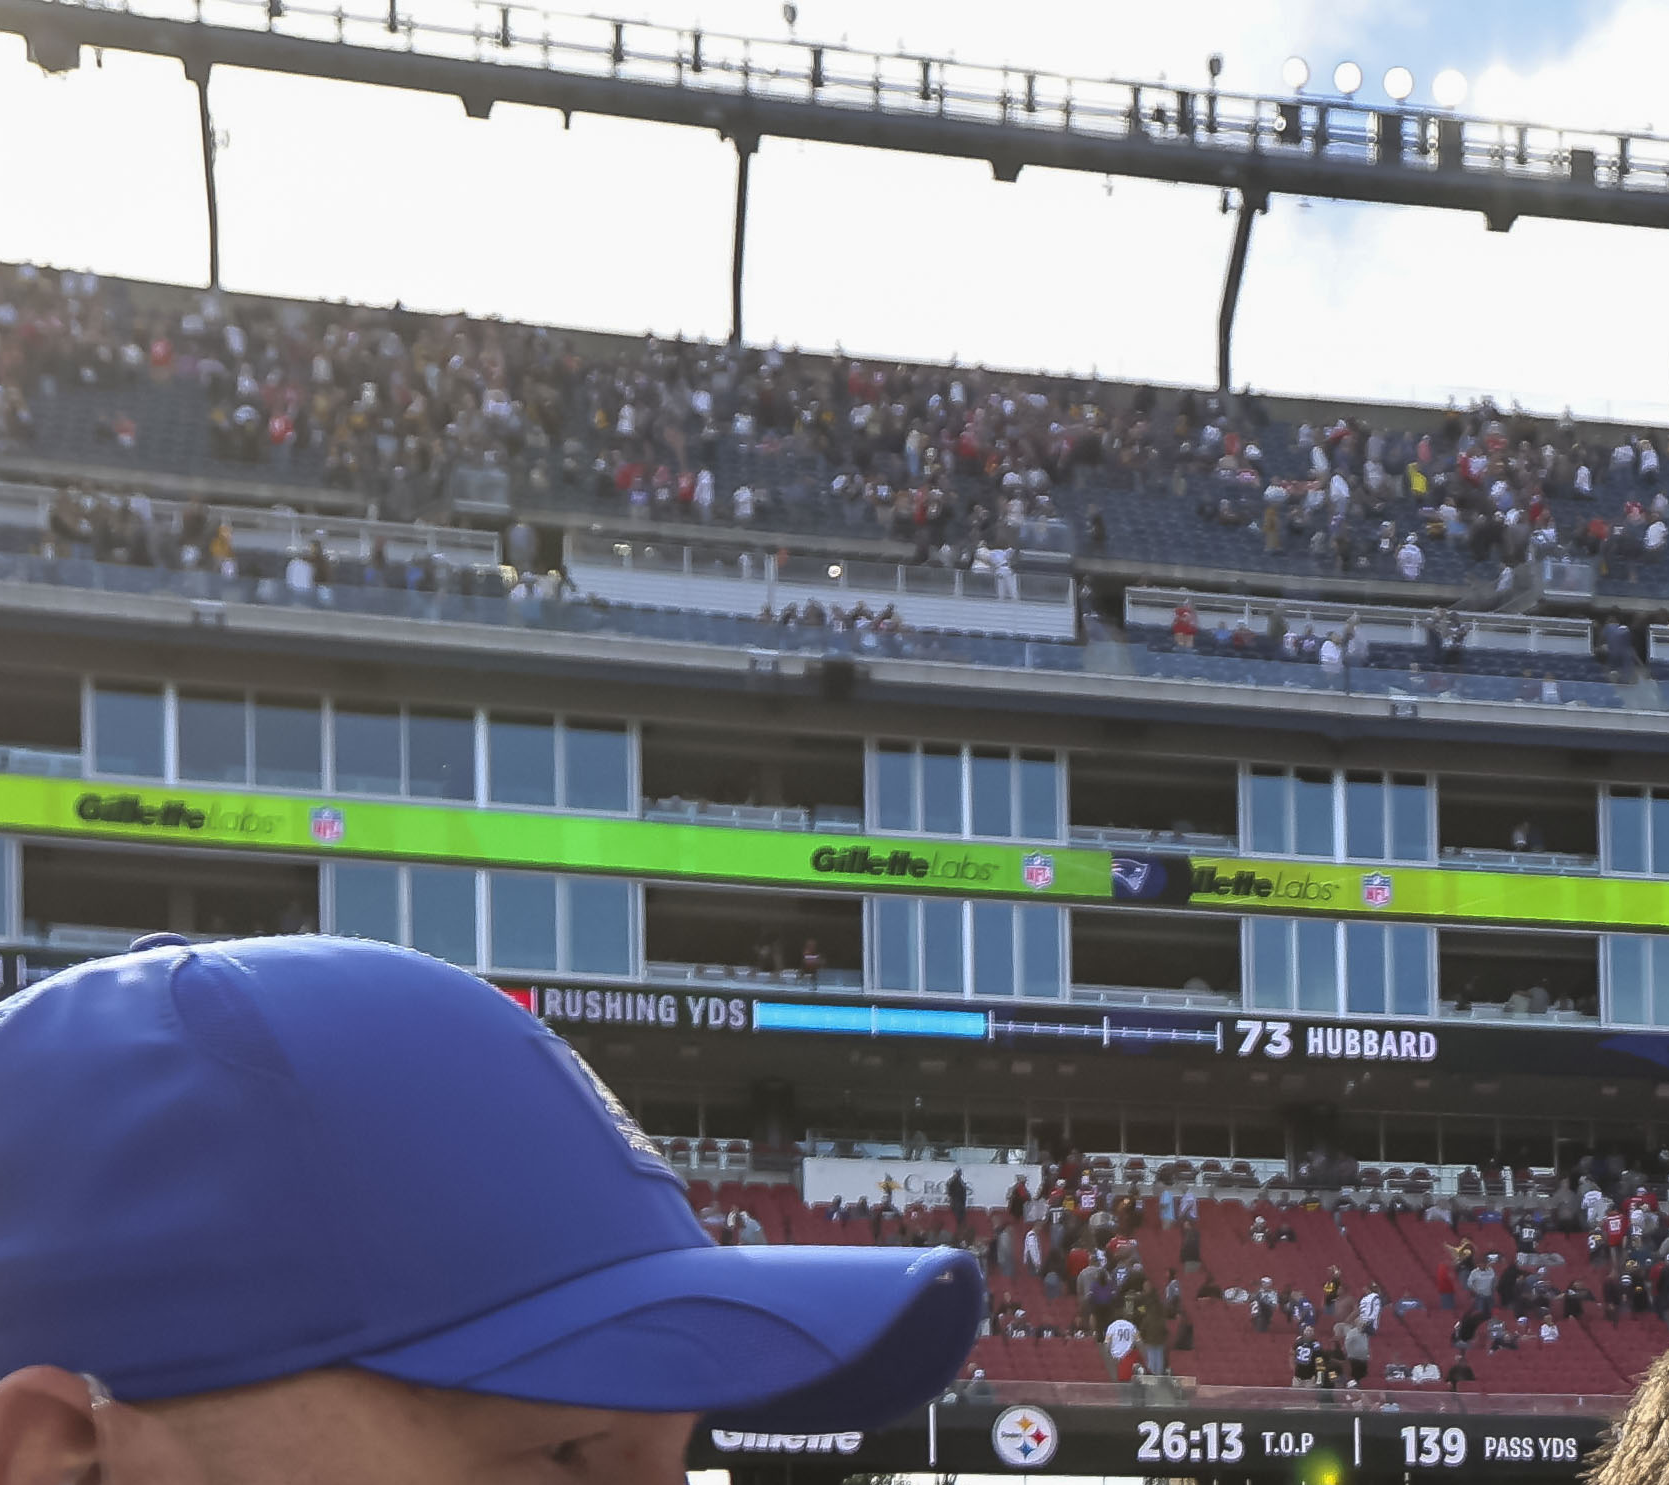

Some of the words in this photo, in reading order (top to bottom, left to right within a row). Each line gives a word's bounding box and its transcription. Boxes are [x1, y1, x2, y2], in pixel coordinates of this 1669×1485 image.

[543, 991, 676, 1027] RUSHING
[686, 998, 747, 1030] YDS
[1235, 1020, 1294, 1058] 73
[1307, 1027, 1438, 1061] HUBBARD
[1137, 1420, 1245, 1464] 26:13
[1400, 1426, 1468, 1467] 139
[1484, 1436, 1534, 1461] PASS
[1537, 1438, 1579, 1463] YDS
